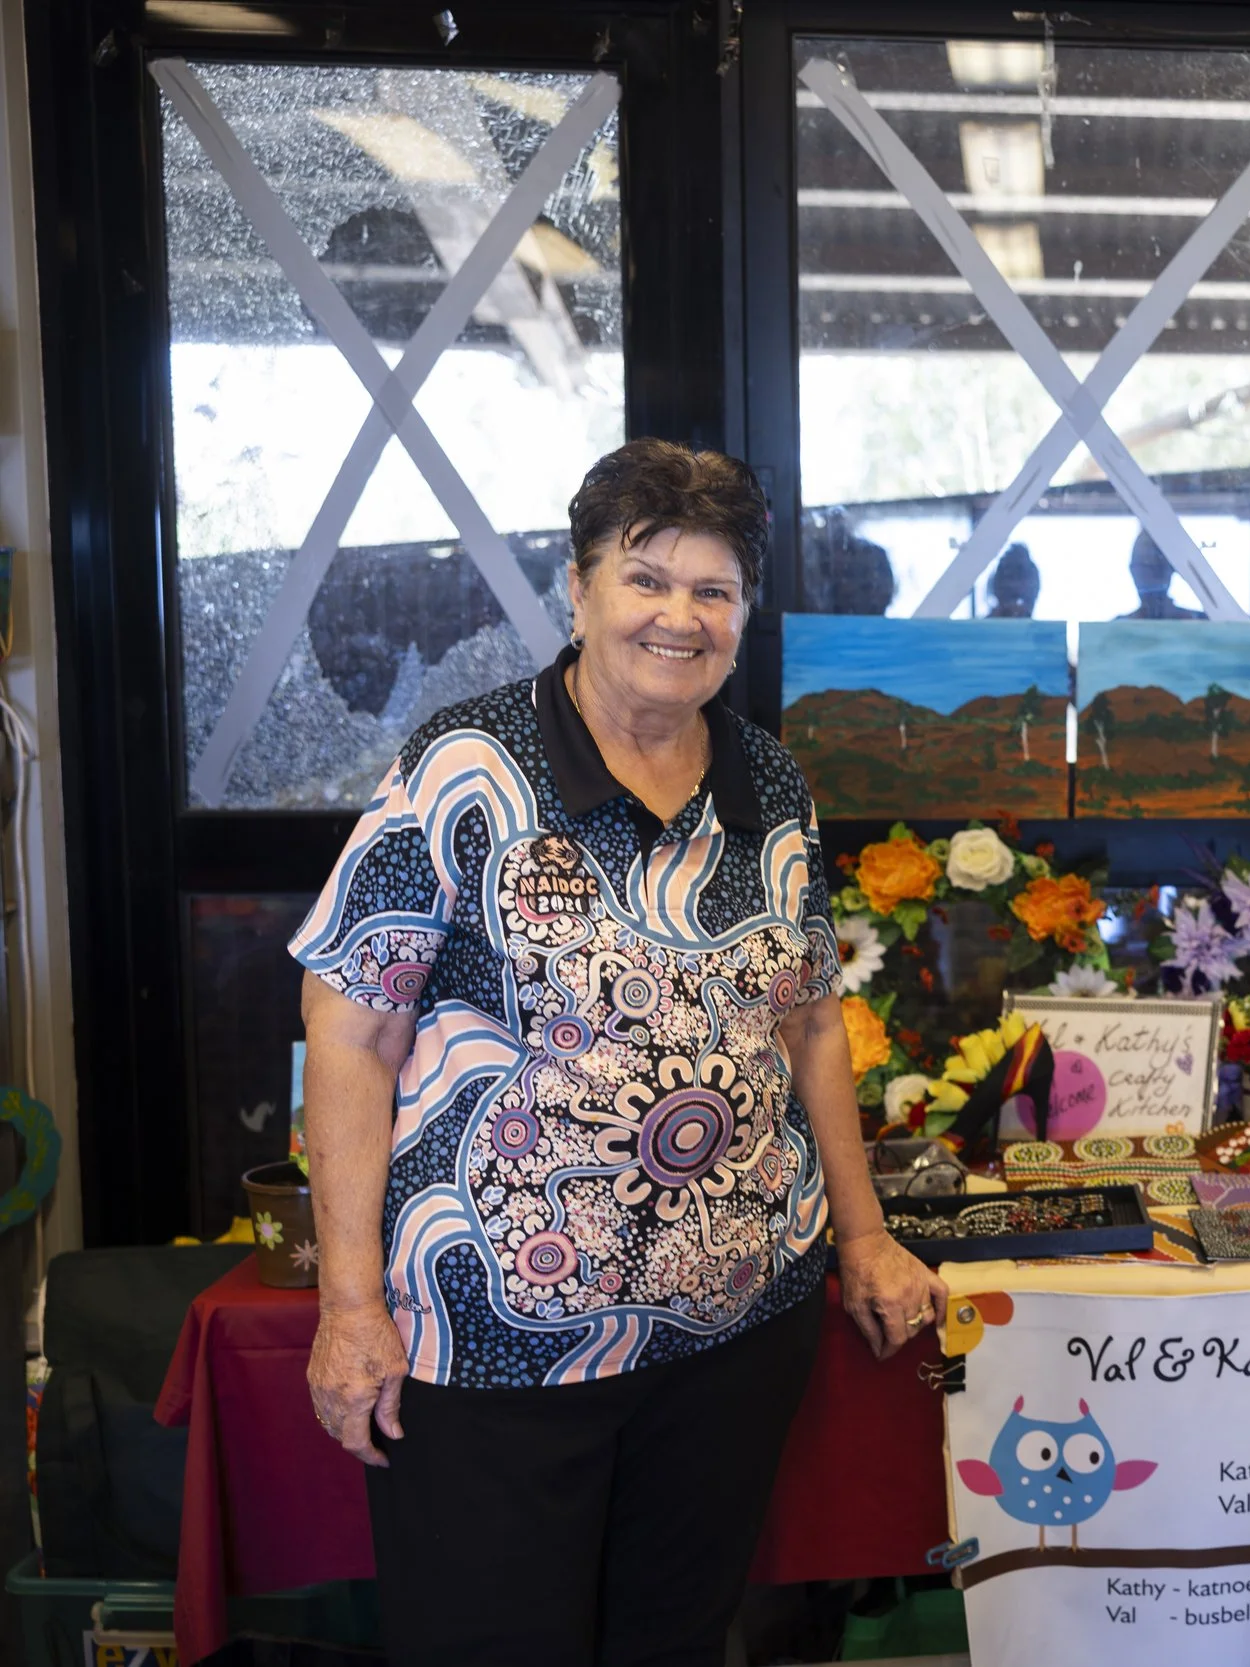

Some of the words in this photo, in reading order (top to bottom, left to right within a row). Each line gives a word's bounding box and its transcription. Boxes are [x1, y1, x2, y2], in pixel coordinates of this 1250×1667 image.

[519, 876, 598, 895] NAIDOC
[1067, 1335, 1146, 1381] Val
[1153, 1337, 1195, 1382] &
[1218, 1493, 1250, 1514] Val
[1106, 1578, 1166, 1600] Kathy
[1106, 1605, 1136, 1624] Val
